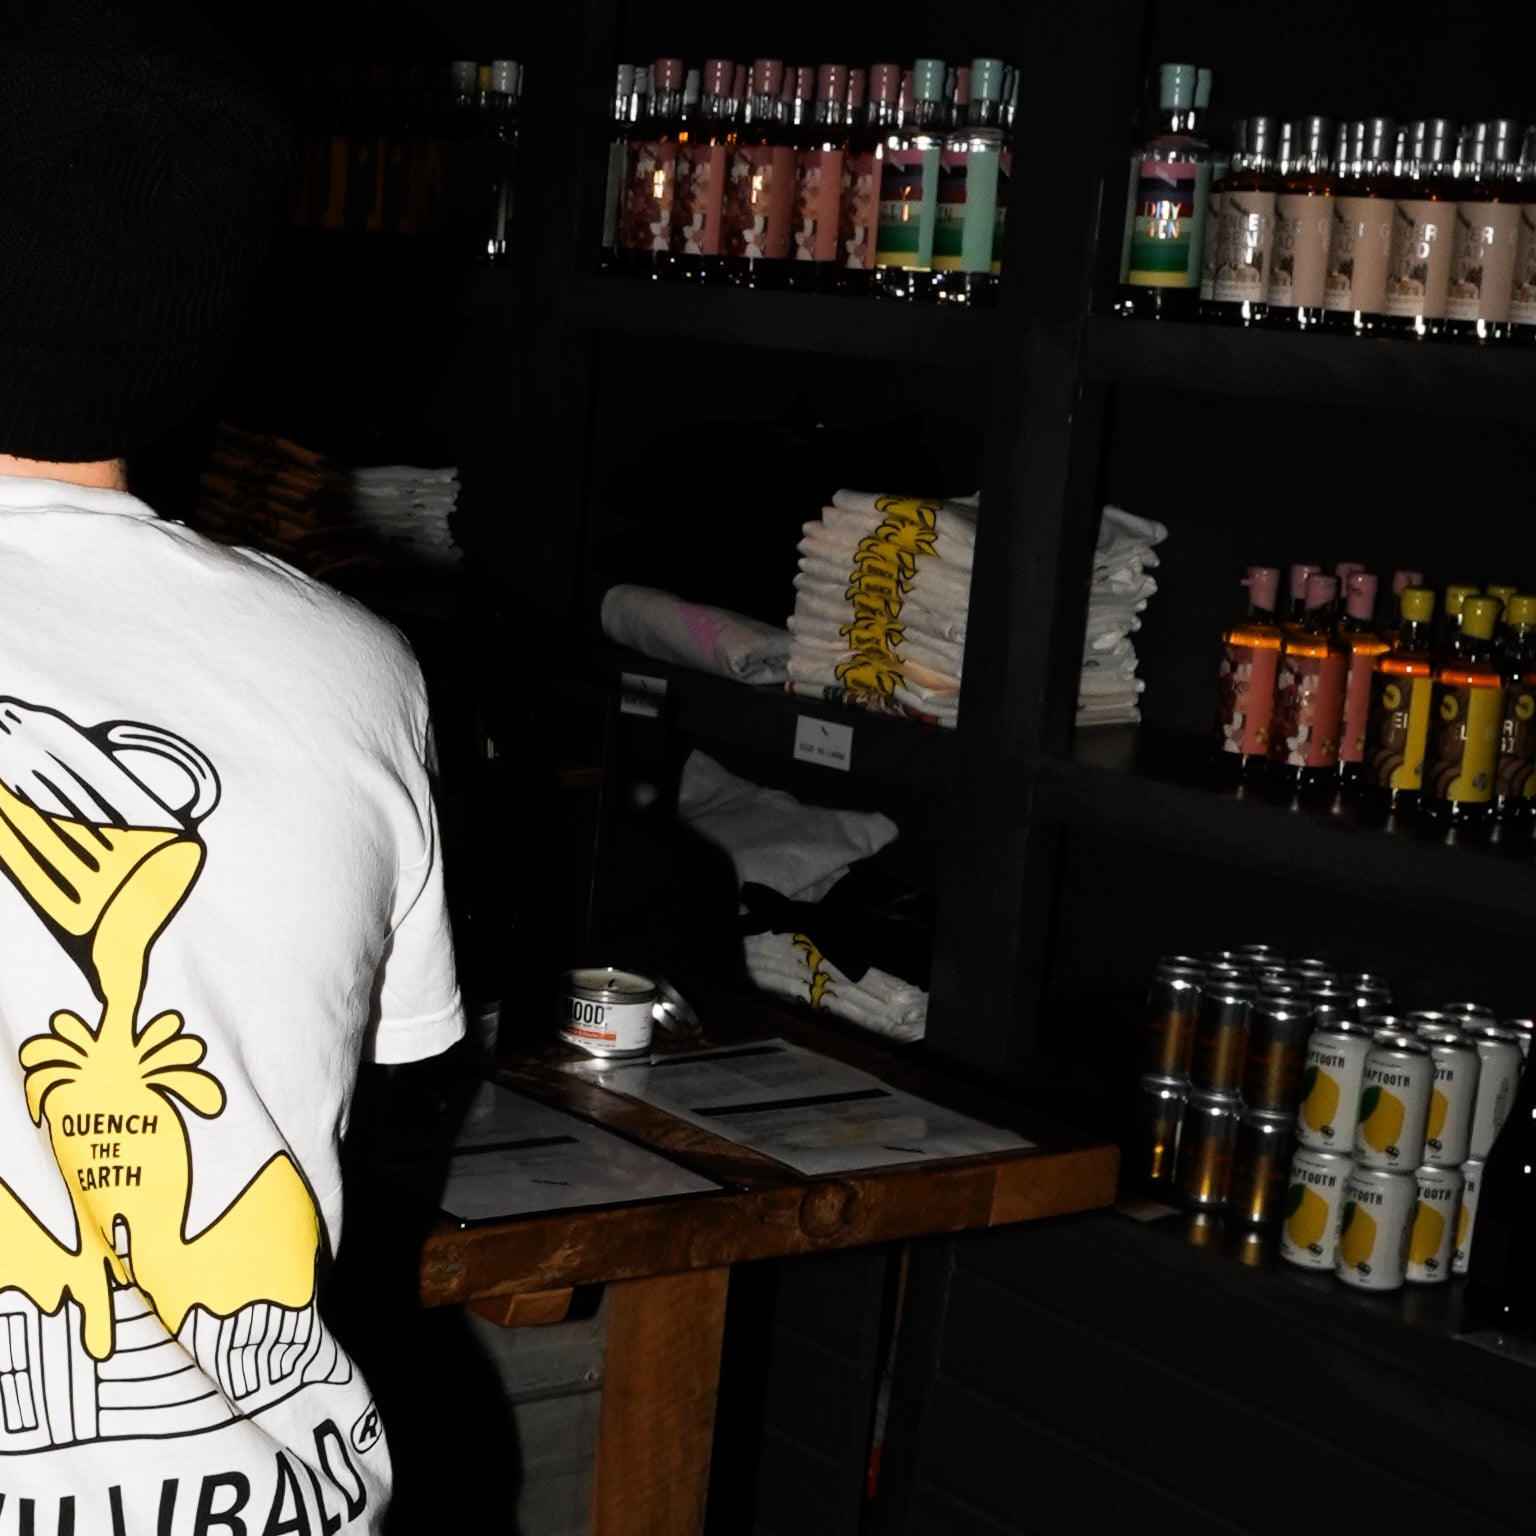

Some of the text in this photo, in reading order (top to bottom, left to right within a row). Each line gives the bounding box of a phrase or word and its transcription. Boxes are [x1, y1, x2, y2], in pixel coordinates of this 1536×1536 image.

[62, 1113, 159, 1137] QUENCH
[90, 1142, 121, 1160] THE
[77, 1165, 142, 1192] EARTH
